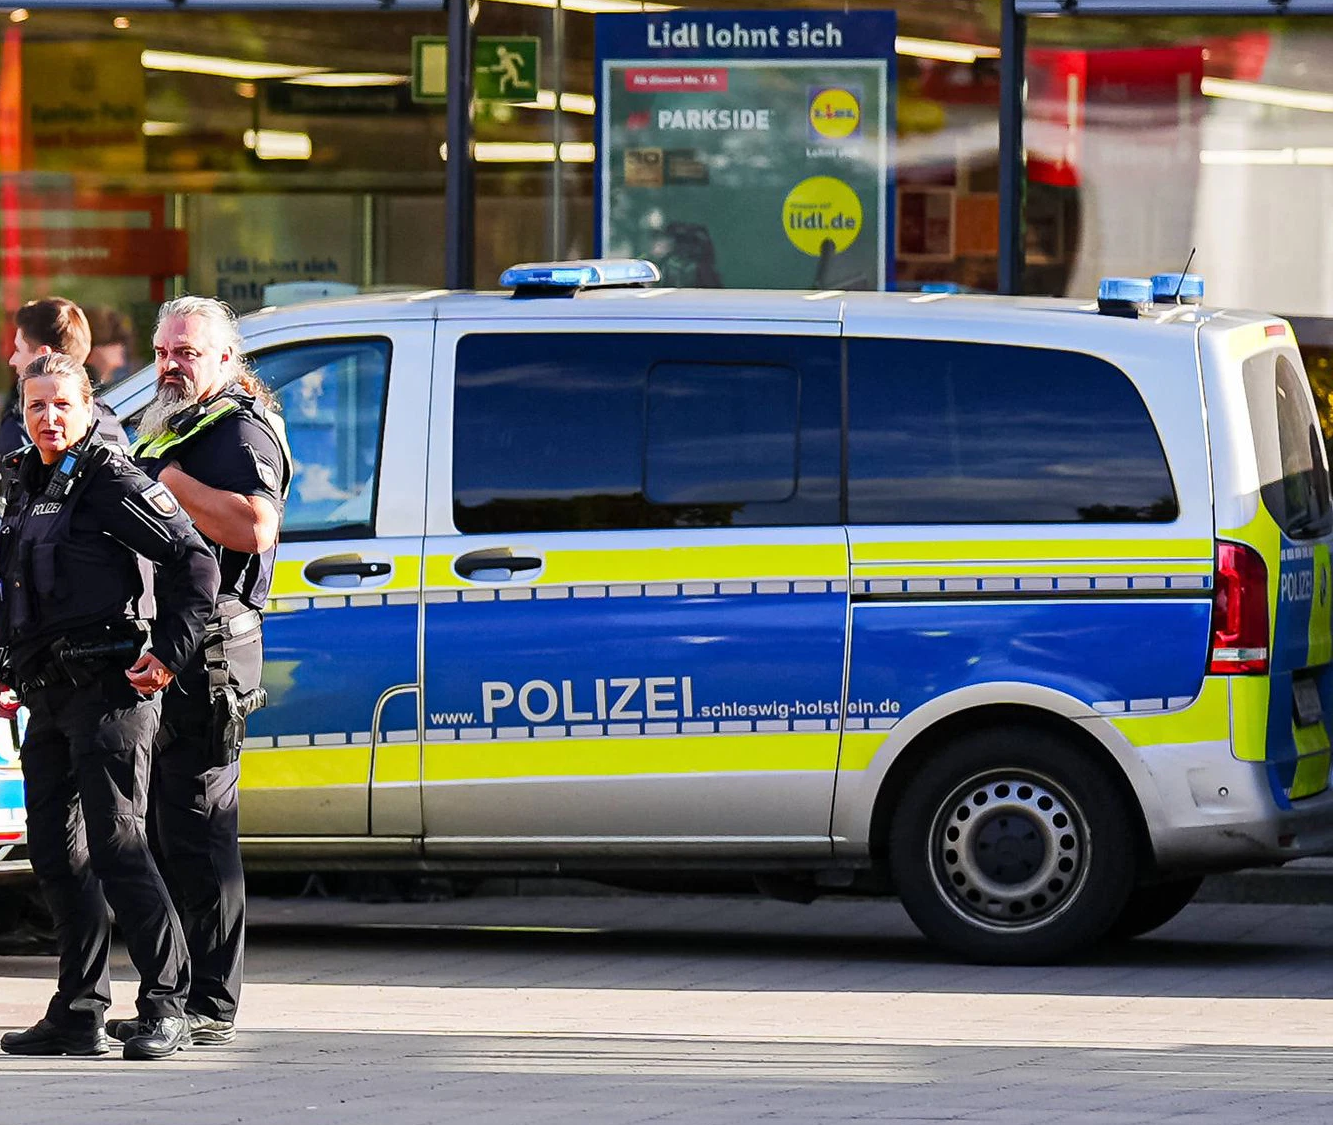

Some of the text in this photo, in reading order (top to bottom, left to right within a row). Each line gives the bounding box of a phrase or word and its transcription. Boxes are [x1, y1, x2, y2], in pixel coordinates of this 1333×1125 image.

[647, 22, 842, 48] Lidl lohnt sich
[658, 109, 770, 130] PARKSIDE
[789, 212, 855, 230] lidl.de
[30, 502, 63, 517] POLIZEI
[481, 676, 695, 724] POLIZEI
